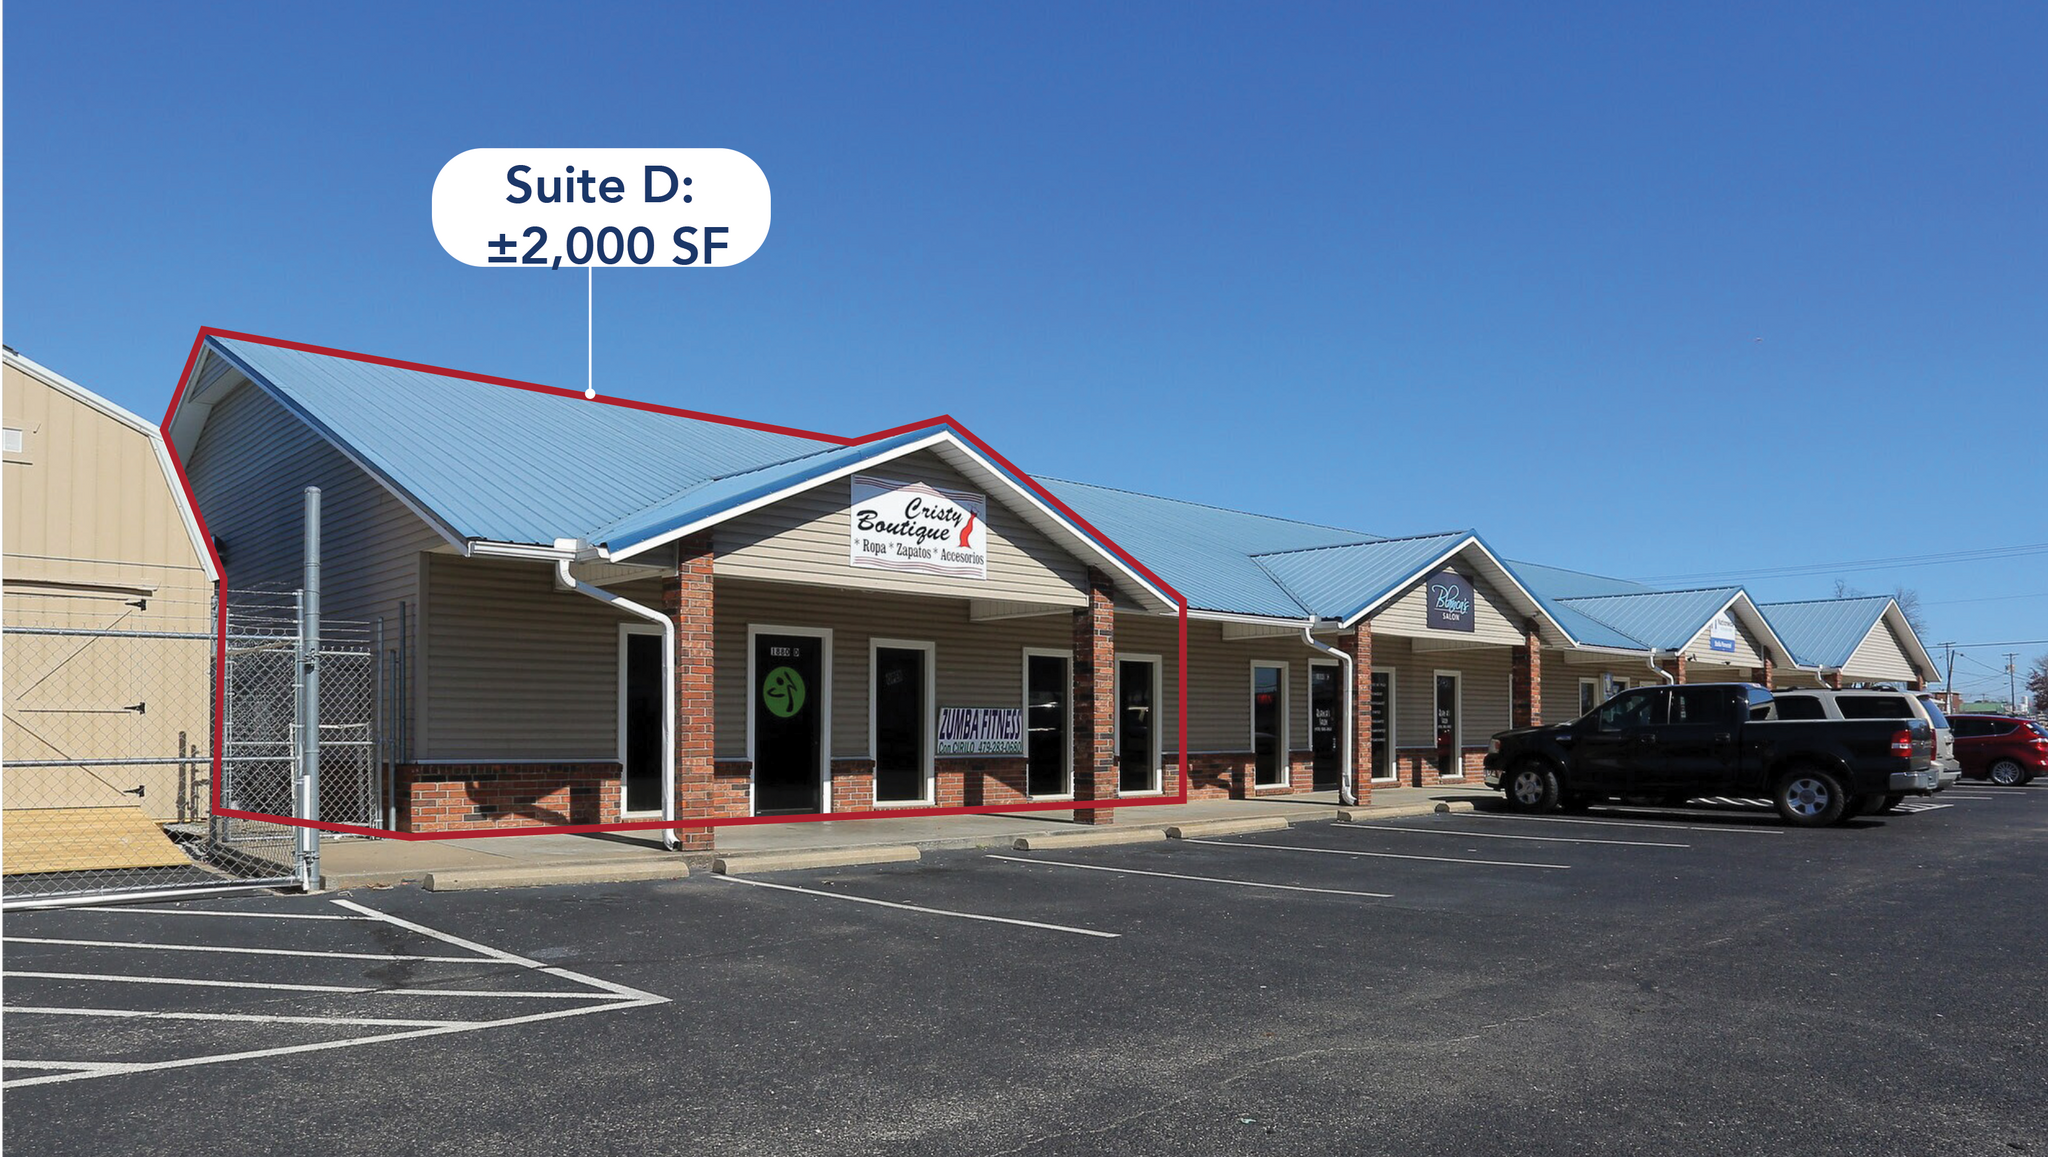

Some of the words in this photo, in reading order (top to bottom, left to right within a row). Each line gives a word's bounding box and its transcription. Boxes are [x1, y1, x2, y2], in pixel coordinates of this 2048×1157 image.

[905, 497, 962, 527] Cristy
[857, 510, 950, 545] Boutique
[863, 539, 887, 556] Ropa
[896, 543, 932, 559] Zapatos
[940, 548, 985, 565] Accesorios
[1442, 612, 1460, 620] SALON
[939, 709, 979, 740] ZUMBA
[980, 709, 1023, 740] FITNESS
